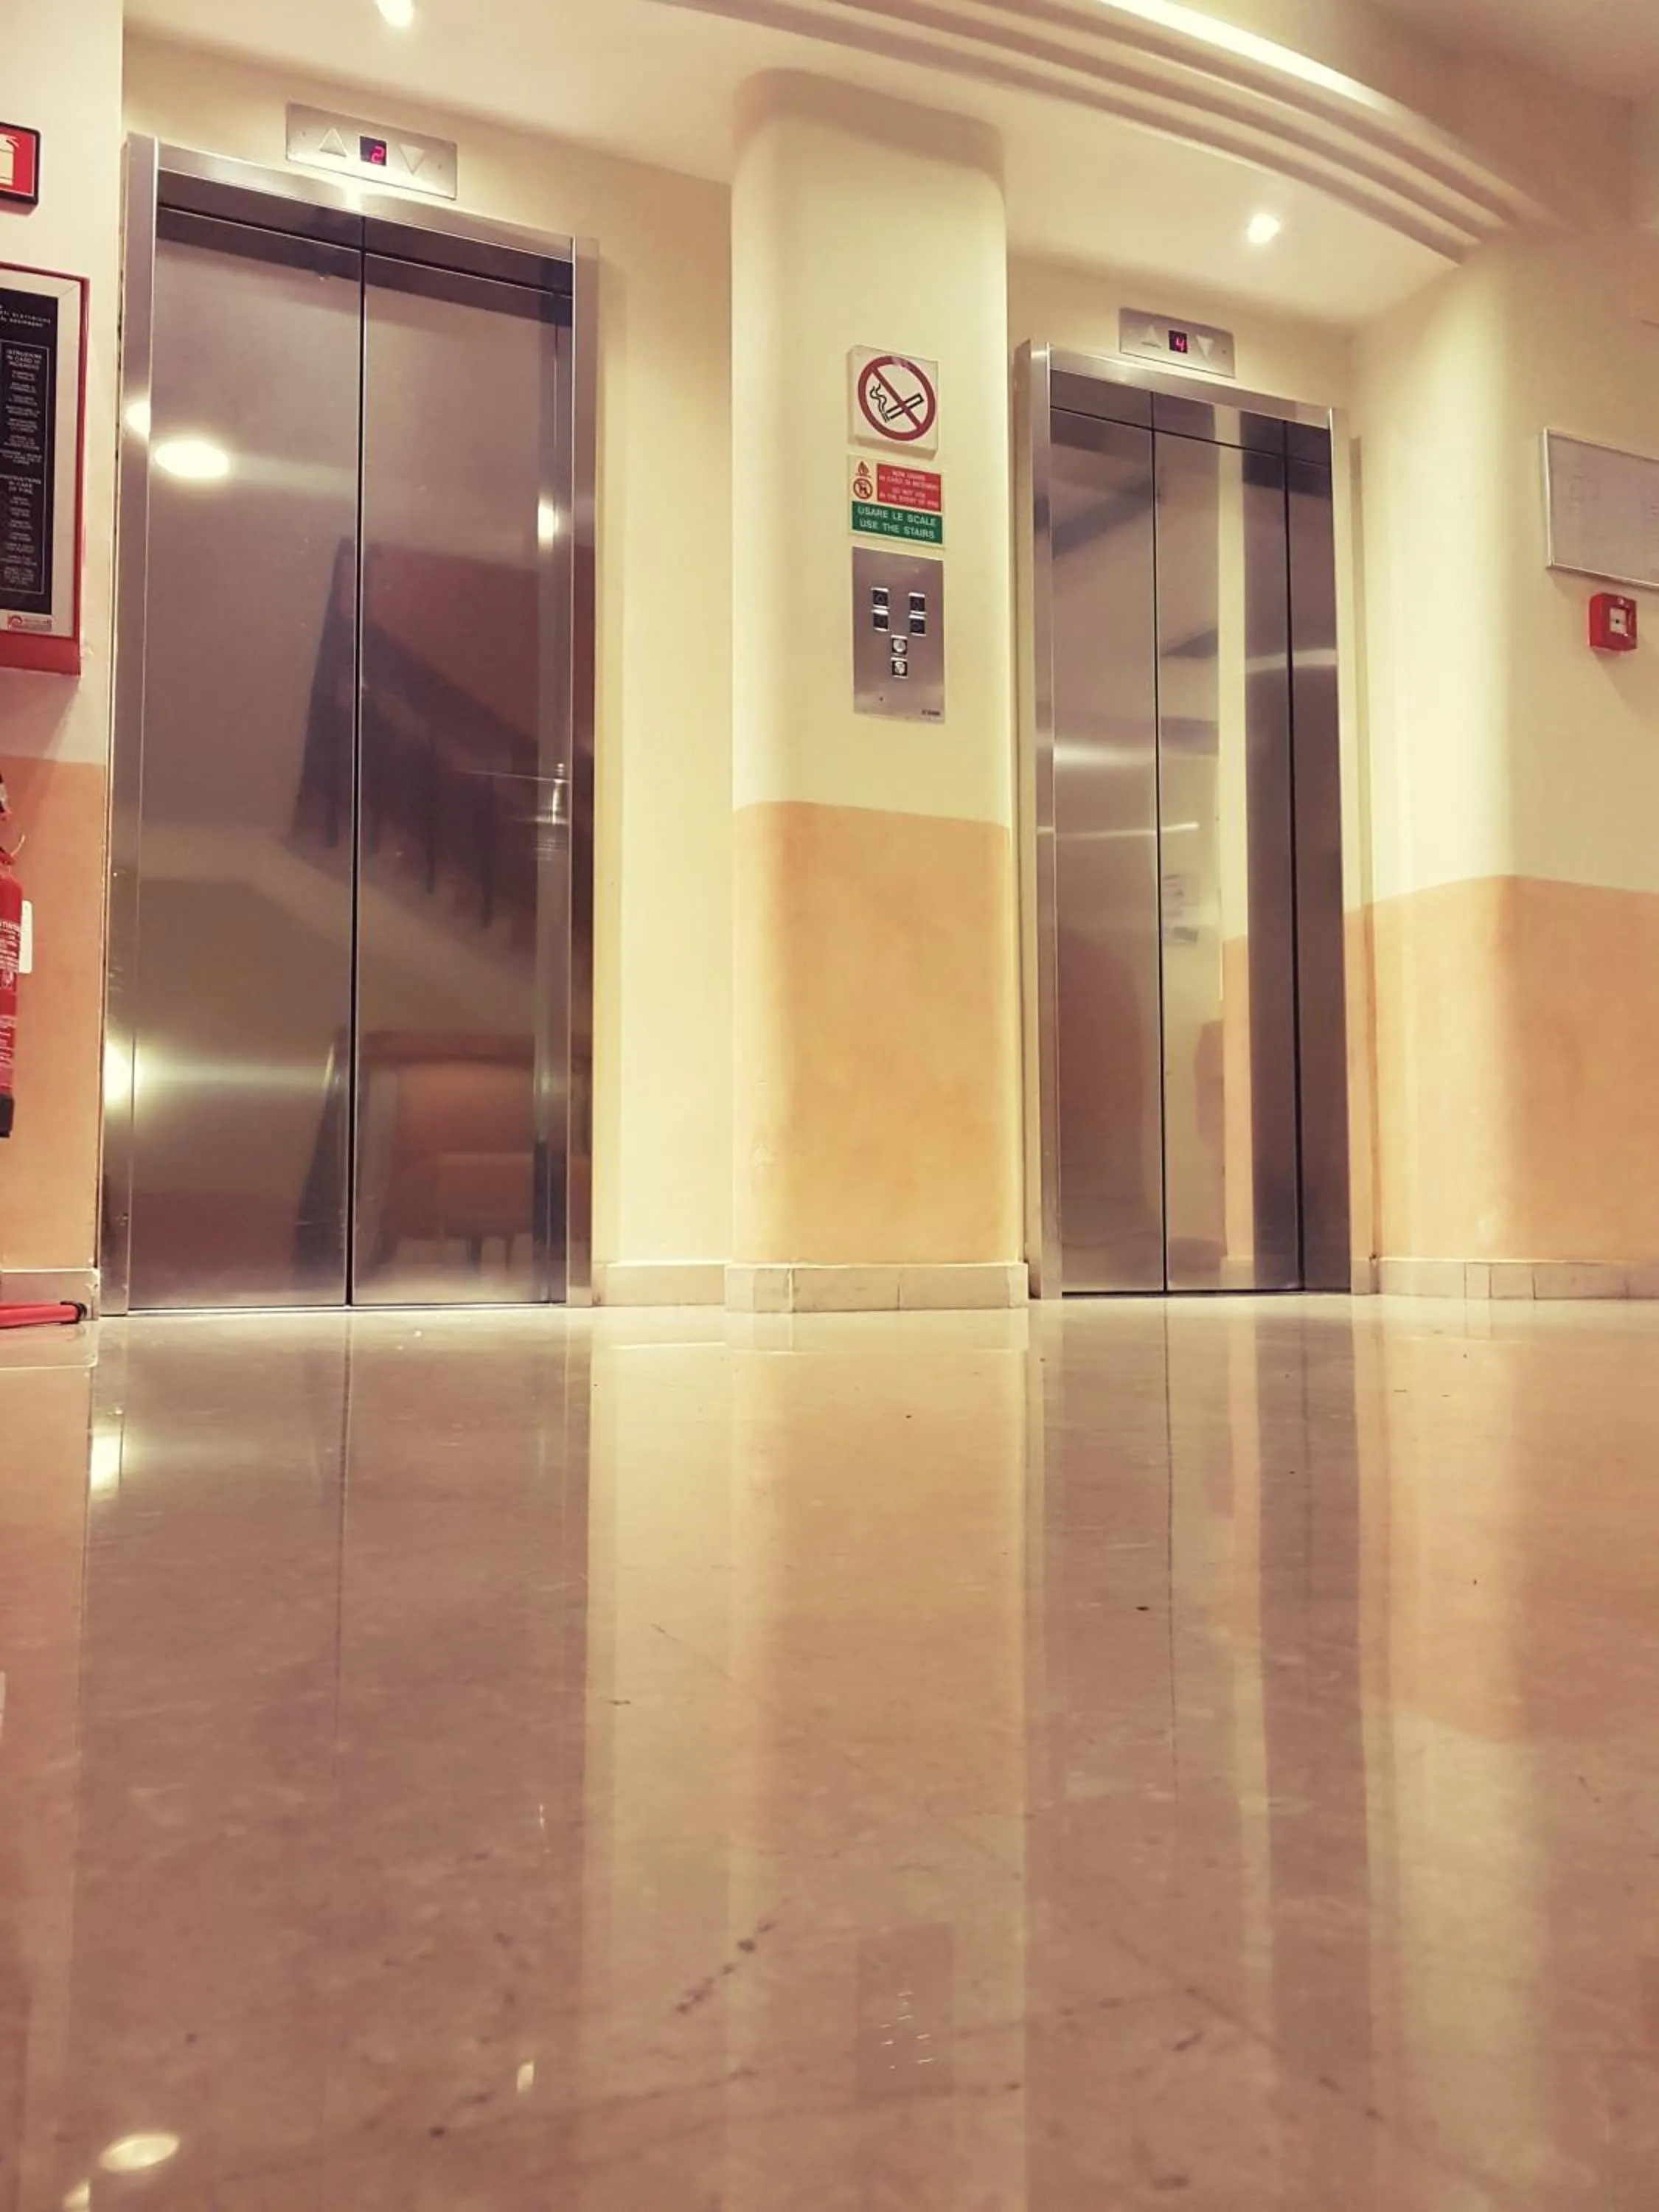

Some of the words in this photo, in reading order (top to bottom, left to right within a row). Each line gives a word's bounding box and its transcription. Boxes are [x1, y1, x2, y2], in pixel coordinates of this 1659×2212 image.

[371, 145, 385, 164] 2
[1176, 336, 1185, 352] 4
[858, 506, 888, 518] USARE
[892, 511, 903, 521] LE
[907, 515, 936, 526] SCALE
[859, 518, 878, 529] USE
[883, 523, 900, 533] THE
[903, 526, 934, 539] STAIRS
